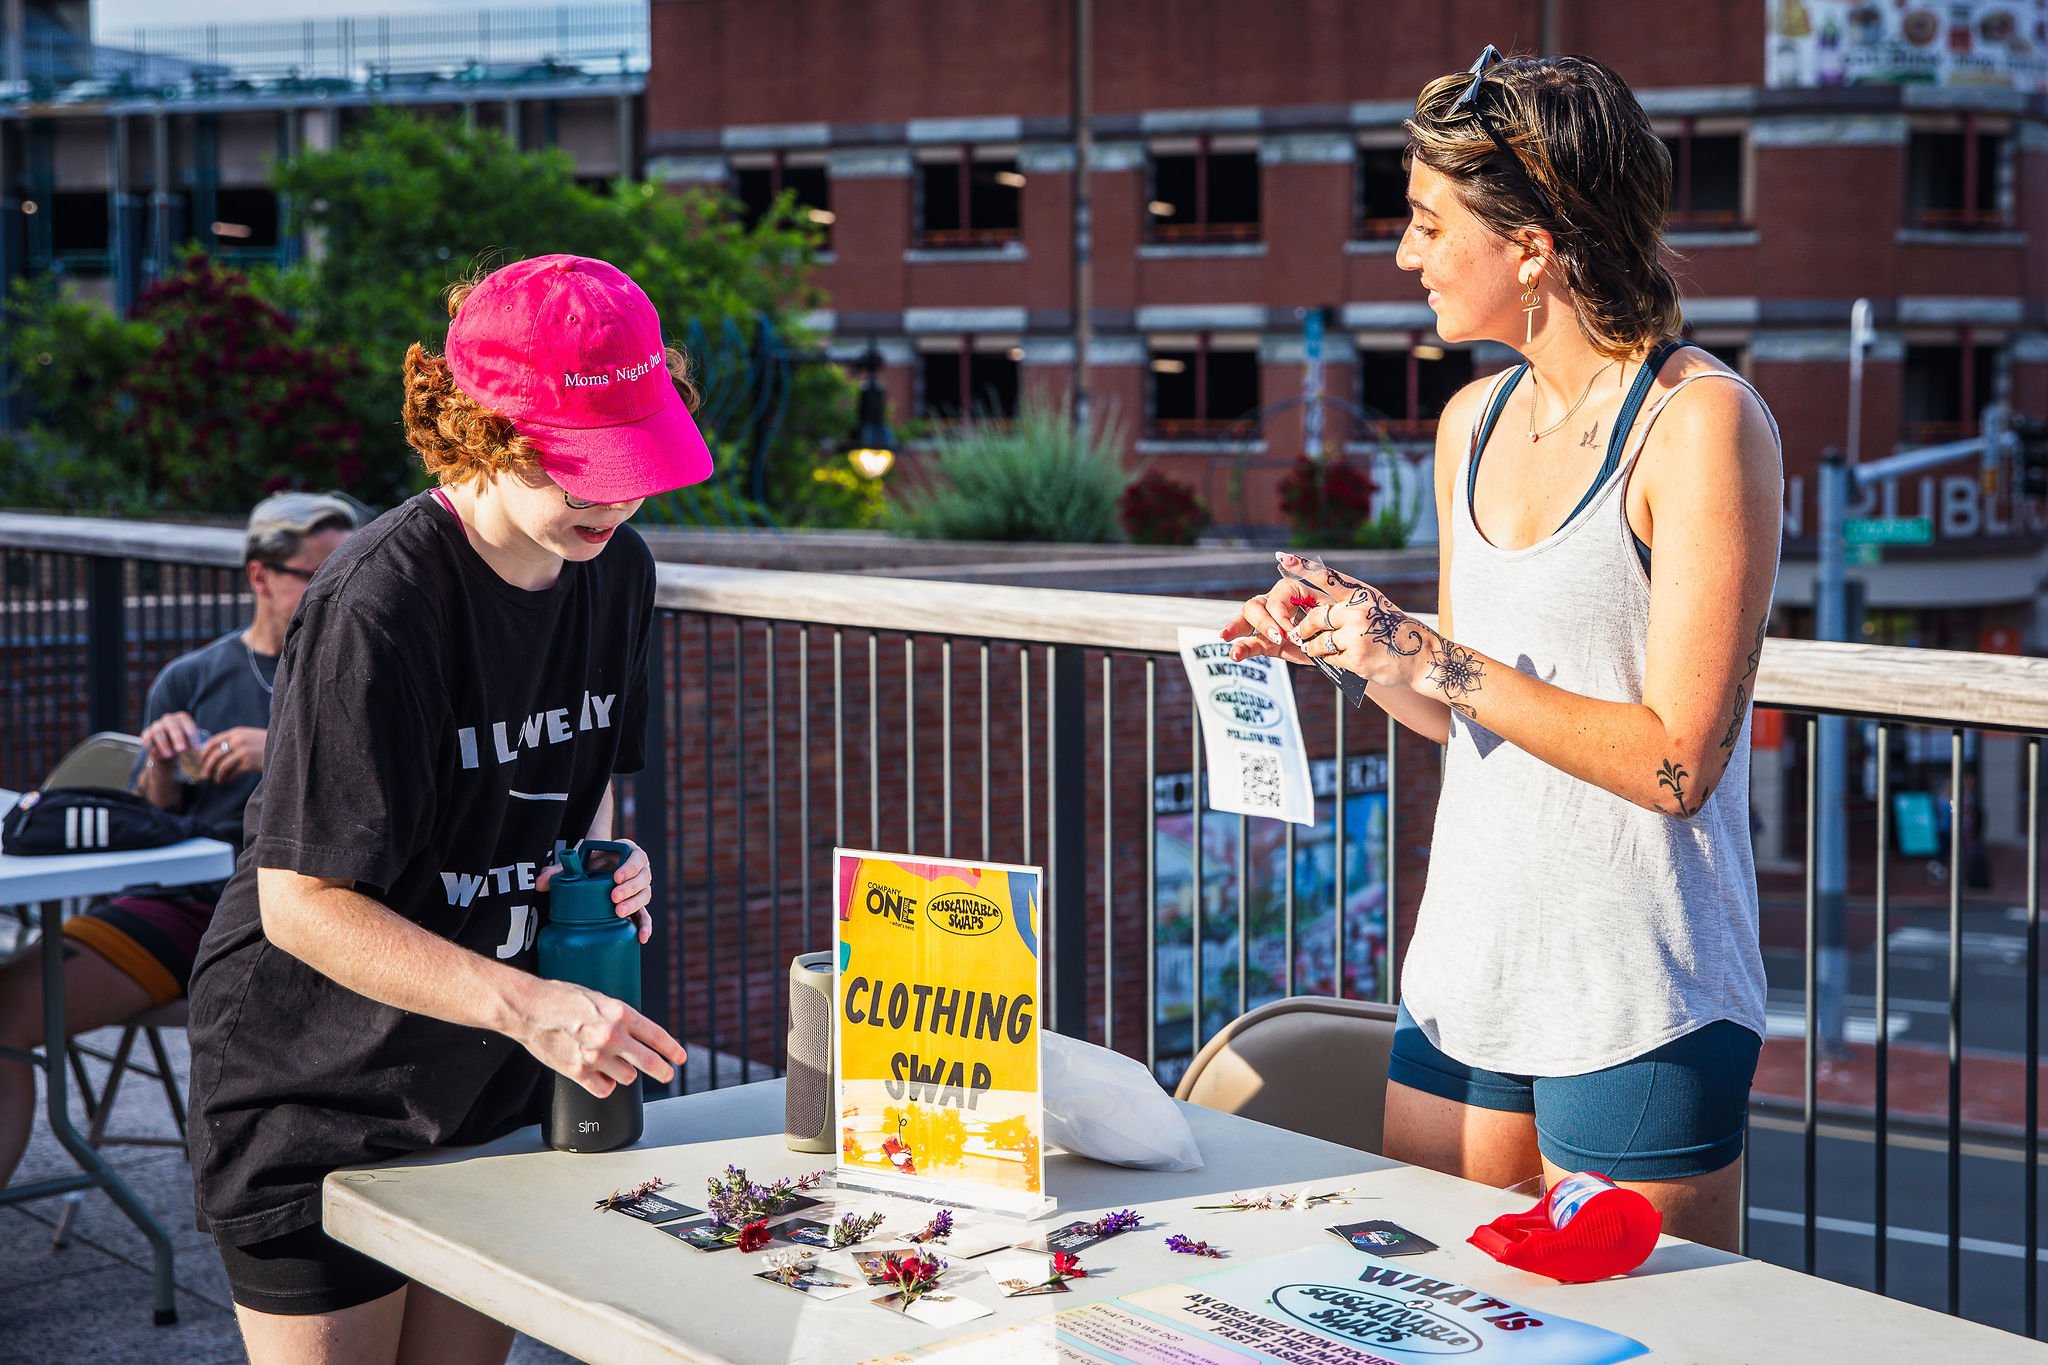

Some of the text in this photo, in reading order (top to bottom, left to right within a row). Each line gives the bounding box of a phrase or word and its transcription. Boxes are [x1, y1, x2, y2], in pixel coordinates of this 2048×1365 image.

[563, 351, 662, 387] Moms Night Out
[458, 726, 479, 769] I
[866, 888, 918, 926] ONE
[867, 881, 902, 896] COMPANY
[948, 913, 984, 931] SWAPS
[844, 976, 1034, 1045] CLOTHING
[884, 1051, 992, 1111] SWAP
[1358, 1265, 1544, 1332] WHAT IS
[1090, 1305, 1125, 1320] WHAT
[1121, 1317, 1143, 1327] DO
[1140, 1325, 1161, 1334] WE
[1157, 1331, 1185, 1344] DO?
[1182, 1303, 1277, 1338] LOWERING
[1271, 1336, 1312, 1352] THE
[1184, 1293, 1217, 1305] AN
[1211, 1302, 1338, 1349] ORGANIZATION
[1208, 1326, 1262, 1344] FAST
[1308, 1308, 1412, 1343] SWAPS
